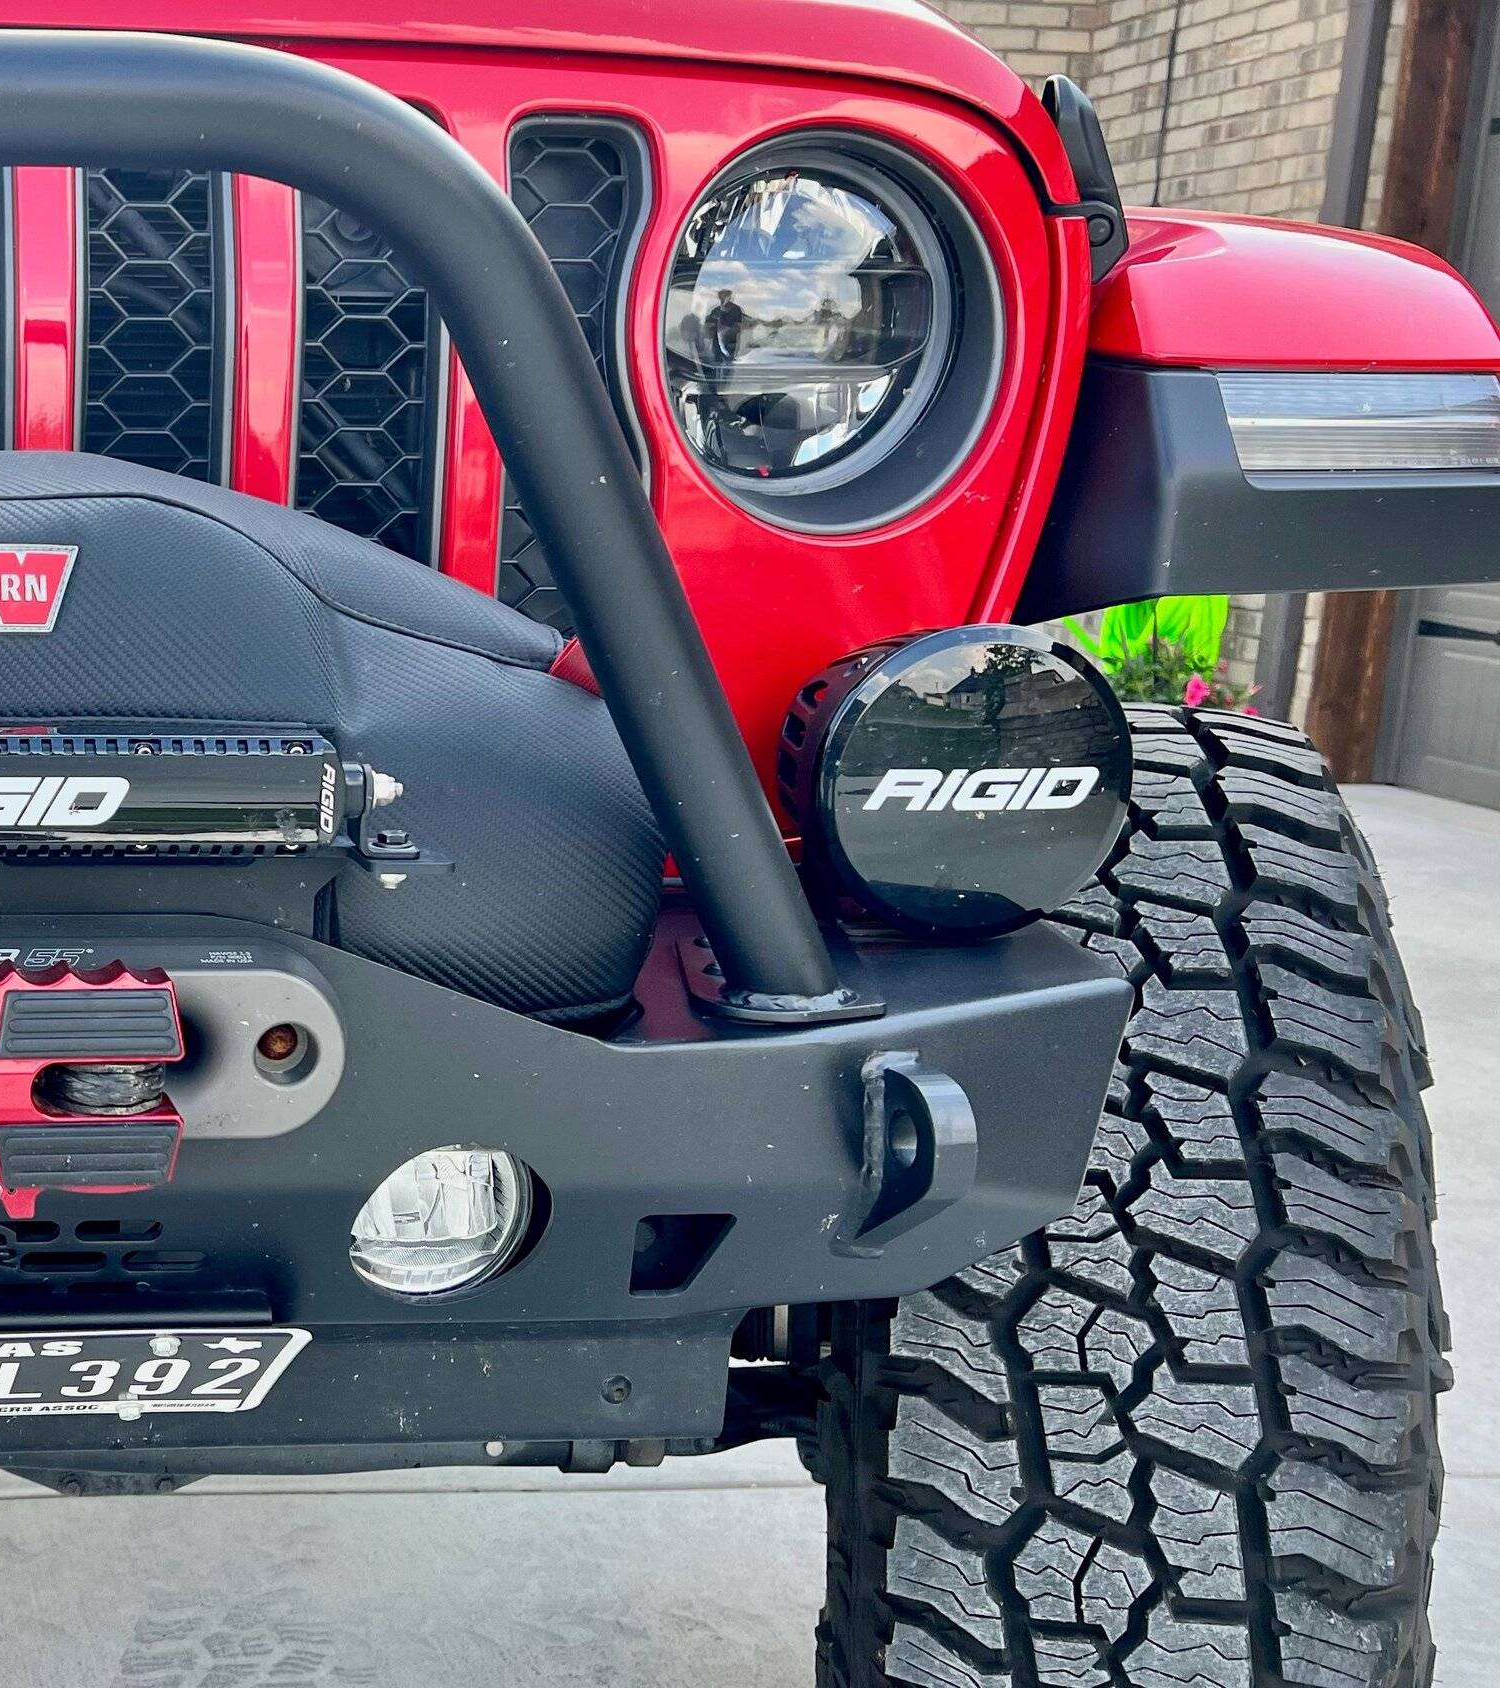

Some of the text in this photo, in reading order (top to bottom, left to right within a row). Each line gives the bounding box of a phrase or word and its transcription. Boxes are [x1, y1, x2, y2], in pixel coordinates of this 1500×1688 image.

[320, 762, 336, 834] RIGID
[862, 766, 1100, 811] RIGID
[40, 1404, 100, 1412] ASSOC
